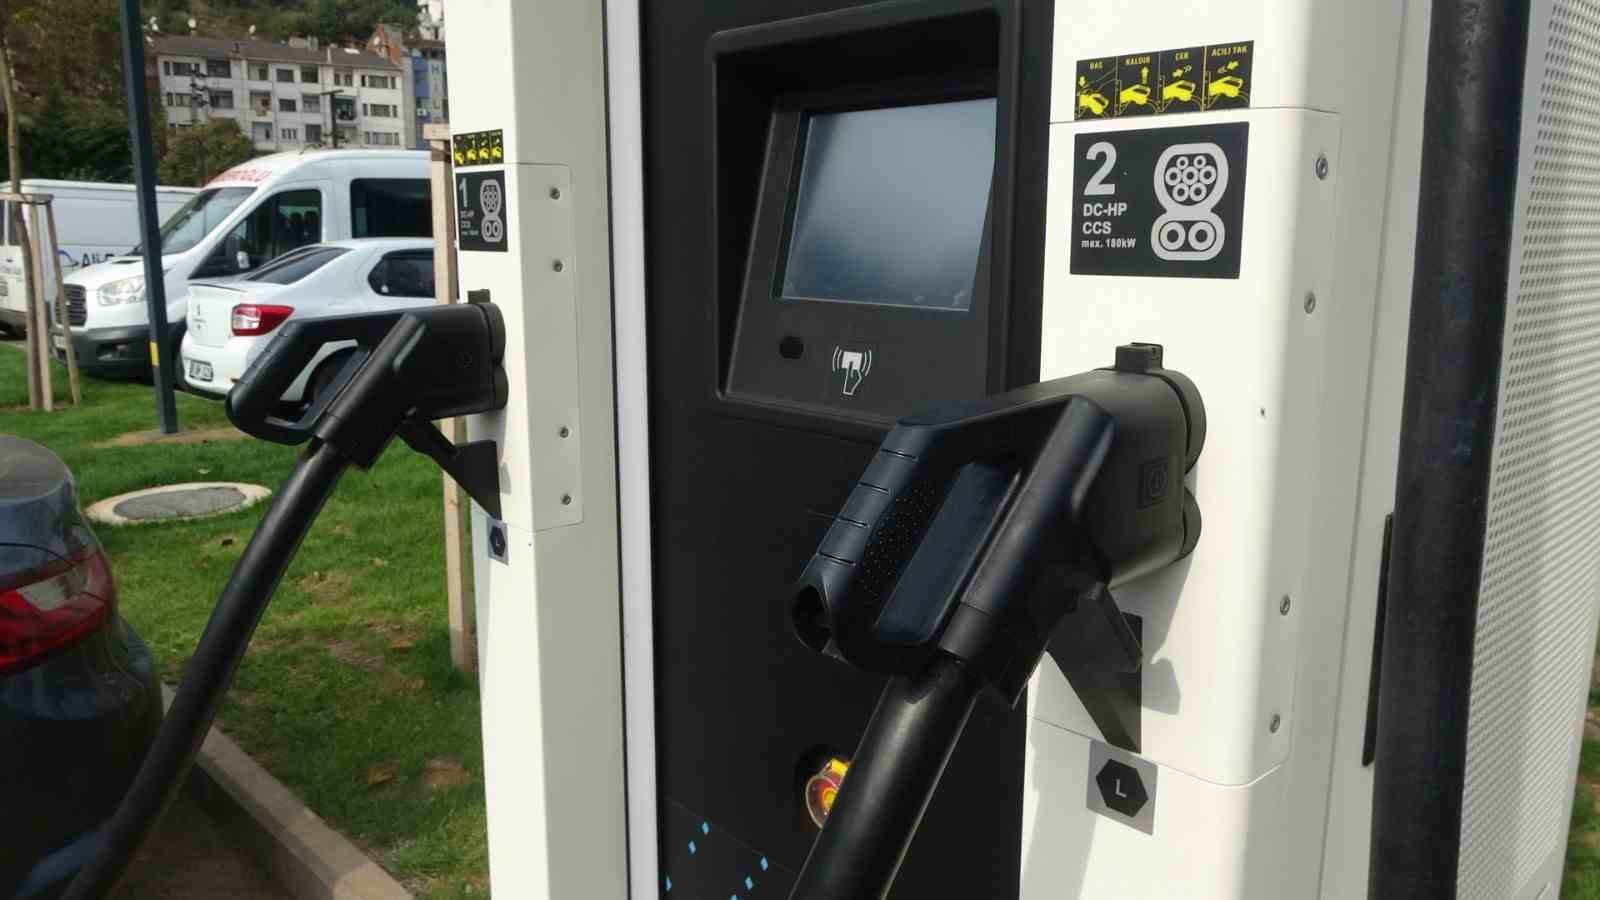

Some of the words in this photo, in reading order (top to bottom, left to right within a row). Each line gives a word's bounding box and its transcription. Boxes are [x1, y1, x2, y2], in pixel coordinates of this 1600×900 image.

[1083, 141, 1117, 196] 2
[459, 177, 468, 208] 1
[1082, 202, 1128, 217] DC-HP
[1082, 221, 1112, 234] CCS
[1081, 239, 1103, 249] max.
[1106, 238, 1137, 249] 180kW
[1116, 779, 1127, 797] L
